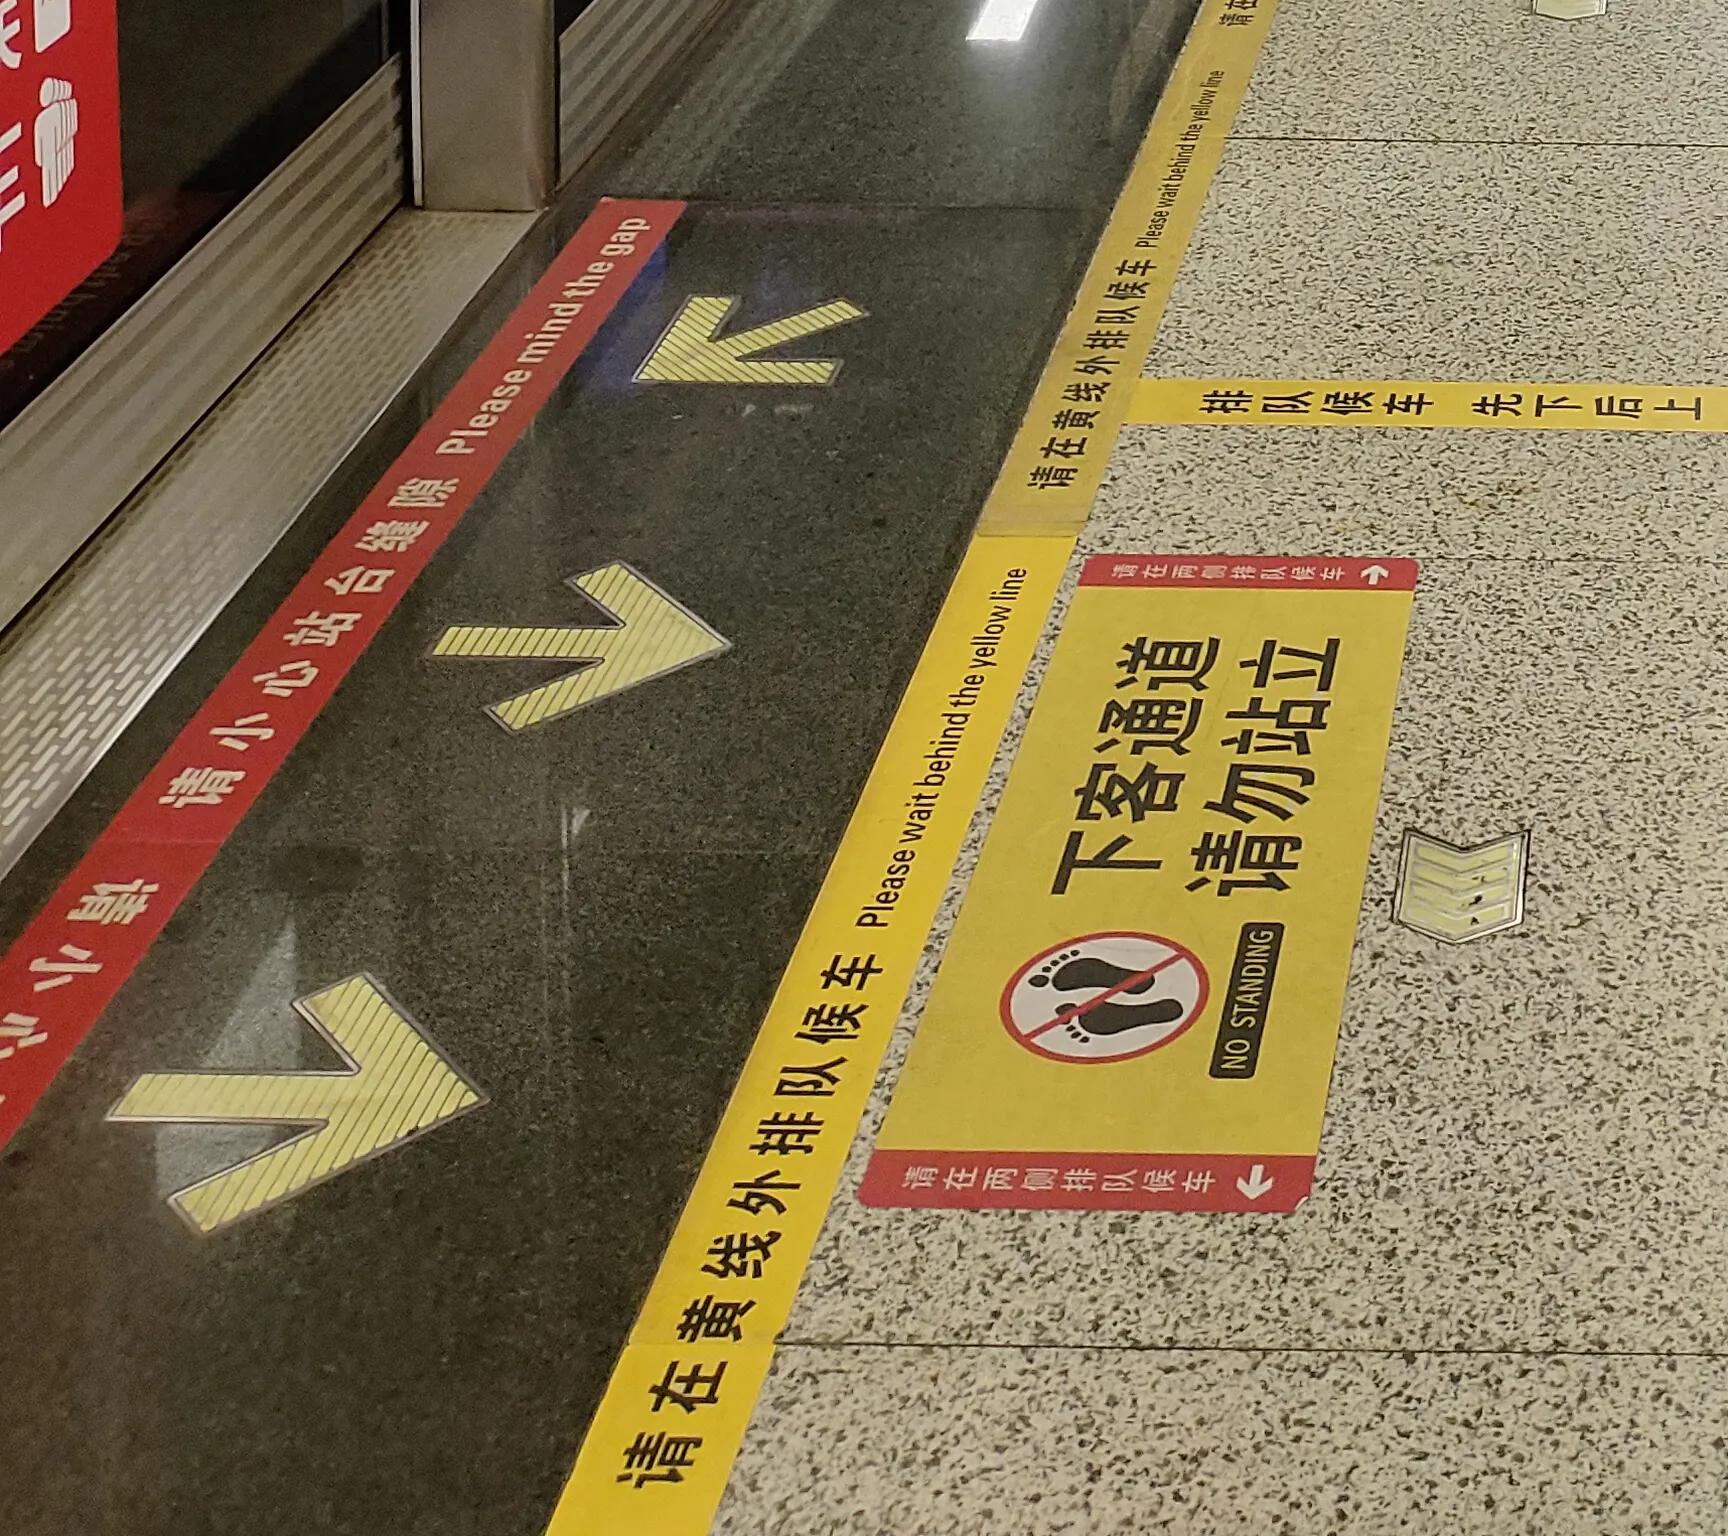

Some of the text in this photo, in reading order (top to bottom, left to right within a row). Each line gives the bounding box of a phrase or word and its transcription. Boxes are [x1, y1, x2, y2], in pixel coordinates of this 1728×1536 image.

[1135, 69, 1225, 249] Please wait behind the yellow line
[436, 217, 651, 455] Please mind the gap
[1027, 258, 1158, 489] 请在黄线外排队候车
[1200, 389, 1704, 421] 排队候车 先下后上
[159, 474, 460, 809] 请小心站台缝隙
[1111, 562, 1346, 582] 请在两侧排队候车
[855, 567, 1027, 928] Please wait behind the yellow line
[1051, 636, 1222, 896] 下客通道
[1185, 637, 1341, 898] 请勿站立
[1221, 929, 1275, 1071] NO STANDING
[616, 951, 886, 1488] 请在黄线外排队候车
[902, 1163, 1218, 1195] 请在两侧排队候车
